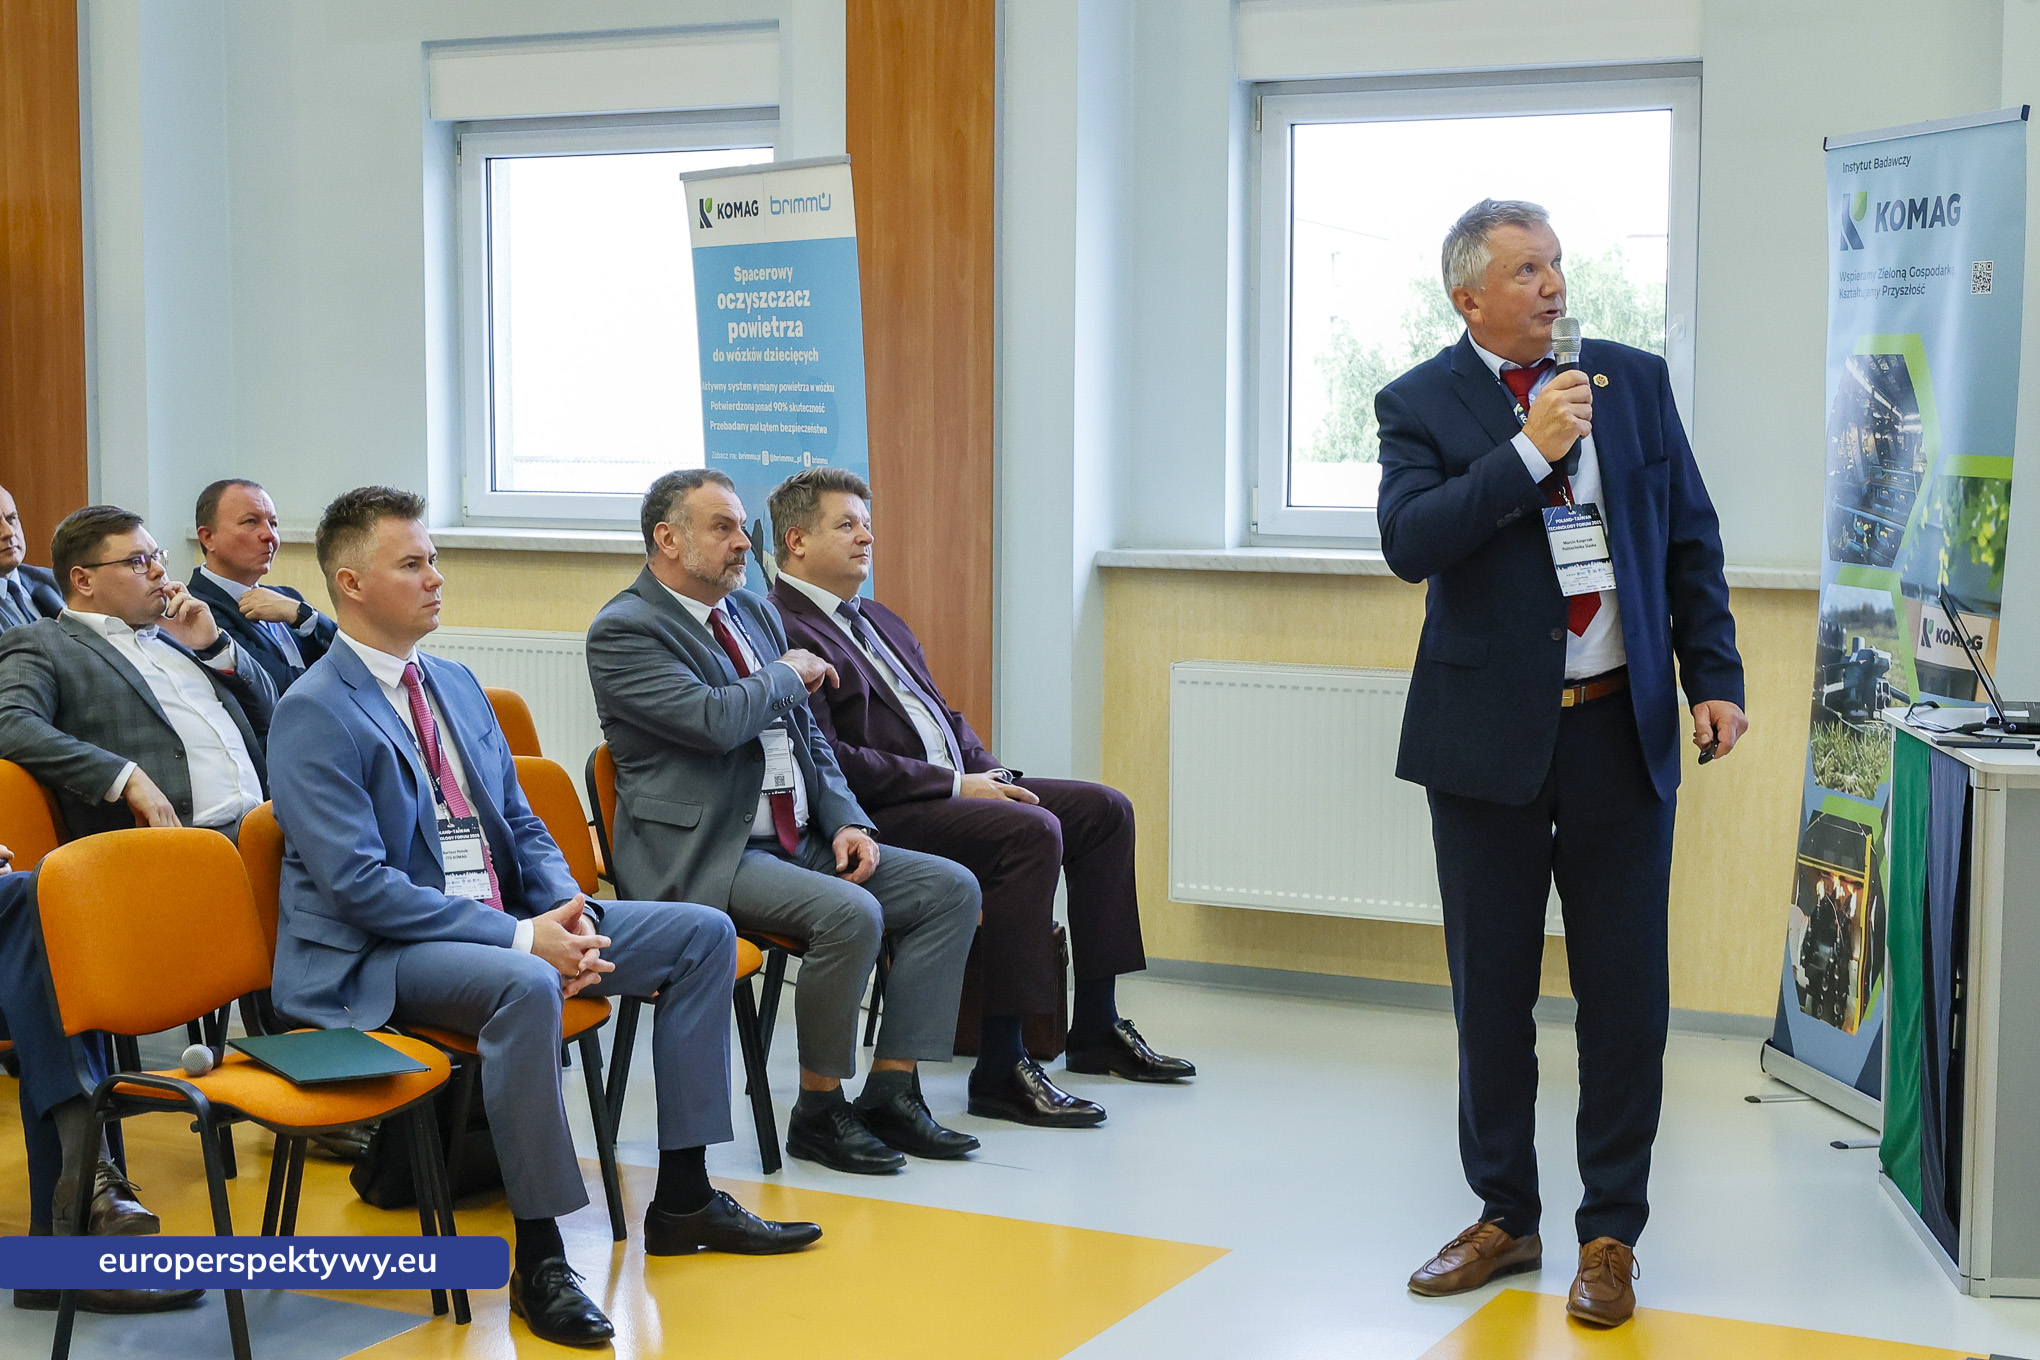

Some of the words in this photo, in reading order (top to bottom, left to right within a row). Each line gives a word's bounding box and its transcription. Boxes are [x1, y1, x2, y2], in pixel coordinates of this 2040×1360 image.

[1842, 158, 1872, 174] Instytut
[1873, 154, 1912, 170] Badawczy
[717, 200, 759, 219] KOMAG
[1874, 193, 1961, 233] KOMAG
[733, 265, 793, 285] Spacerowy
[1838, 269, 1877, 283] Wspieramy
[1877, 266, 1907, 281] Zieloną
[1881, 283, 1926, 299] Przyszłość
[717, 289, 811, 314] oczyszczacz
[728, 315, 804, 344] powietrza
[713, 348, 725, 362] do
[726, 347, 763, 362] wózków
[763, 347, 819, 365] dziecięcych
[728, 381, 752, 393] system
[752, 381, 778, 394] wymiany
[778, 382, 810, 393] powietrza
[815, 382, 835, 393] wózku
[710, 401, 755, 412] Potwierdzona
[755, 402, 773, 413] ponad
[773, 401, 788, 412] 90%
[789, 402, 826, 414] skuteczność
[710, 420, 749, 433] Przebadany
[749, 422, 760, 433] pod
[760, 422, 779, 434] kątem
[780, 422, 828, 435] bezpieczeństwa
